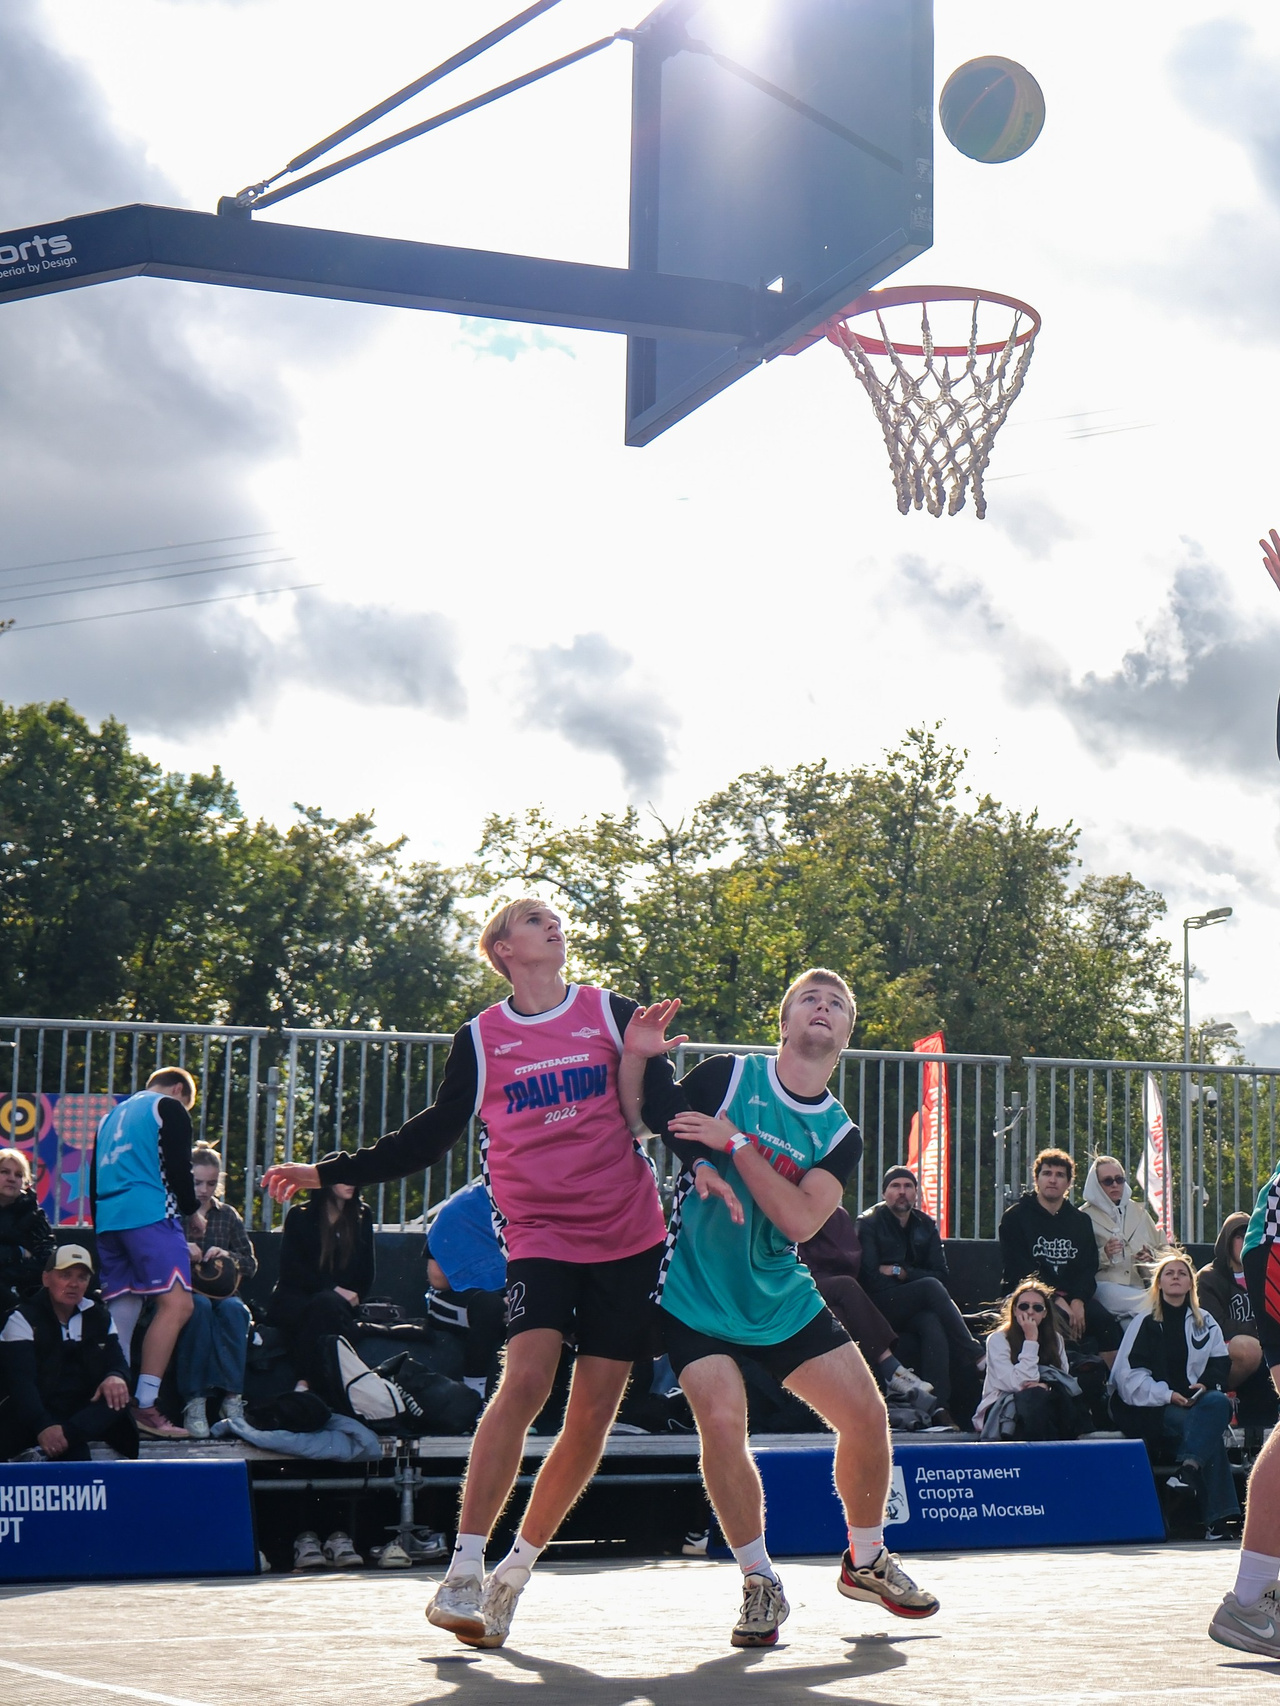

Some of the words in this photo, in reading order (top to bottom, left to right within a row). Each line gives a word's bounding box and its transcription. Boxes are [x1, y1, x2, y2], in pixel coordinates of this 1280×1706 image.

[27, 263, 40, 274] by
[41, 256, 78, 270] Design
[514, 1053, 590, 1076] СТРИТБАСКЕТ
[503, 1063, 607, 1115] ГРАН-ПРИ
[544, 1104, 578, 1125] 2026
[915, 1467, 1021, 1484] Департамент
[0, 1479, 107, 1512] КОВСКИЙ
[918, 1487, 974, 1503] спорта
[921, 1506, 978, 1522] города
[981, 1503, 1045, 1518] Москвы
